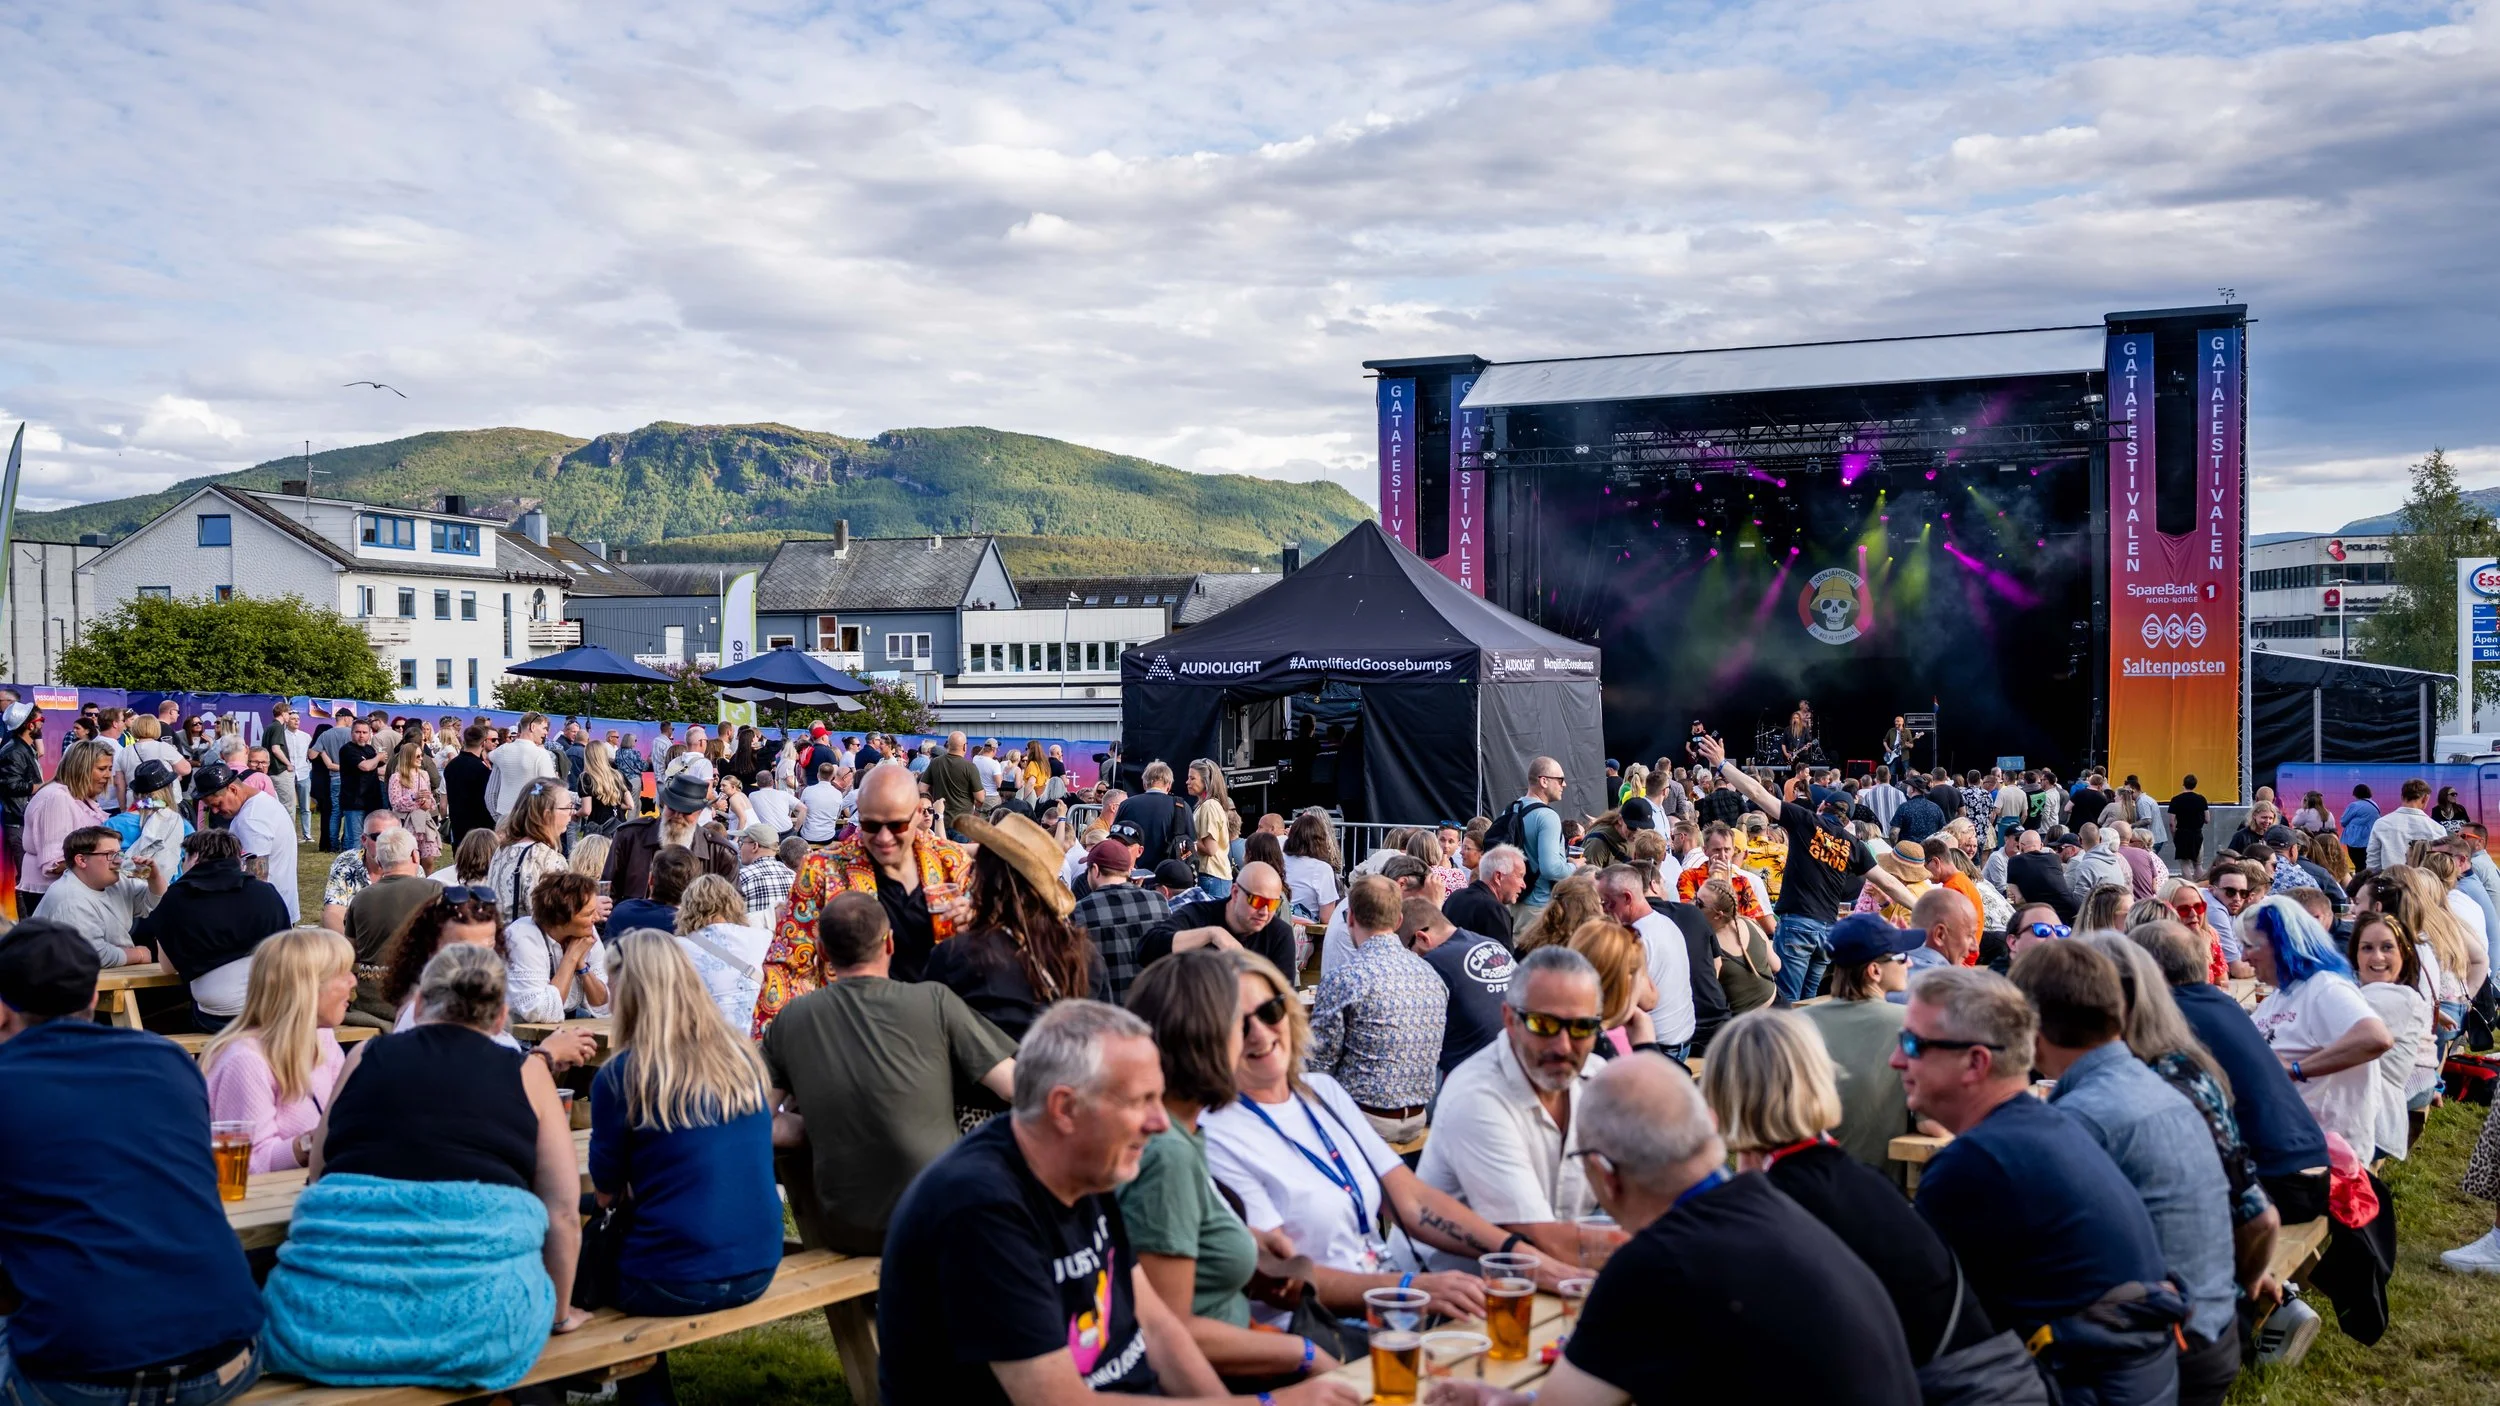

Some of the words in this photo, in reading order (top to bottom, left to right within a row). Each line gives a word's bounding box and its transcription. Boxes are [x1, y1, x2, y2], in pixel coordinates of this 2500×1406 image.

[2123, 342, 2140, 572] GATAFESTIVALEN
[2208, 336, 2226, 570] GATAFESTIVALEN
[1460, 381, 1473, 590] GTAFESTIVALEN
[2346, 543, 2377, 552] POLAR
[1814, 570, 1859, 584] SENJAHOPEN
[2127, 582, 2198, 598] SpareBank
[2474, 634, 2498, 645] Åpen
[1179, 660, 1262, 674] AUDIOLIGHT
[1289, 656, 1452, 674] #AmplifiedGoosebumps
[1504, 658, 1536, 672] AUDIOLIGHT
[1543, 657, 1594, 672] #AmplifiedGoosebumps
[2123, 657, 2226, 680] Saltenposten
